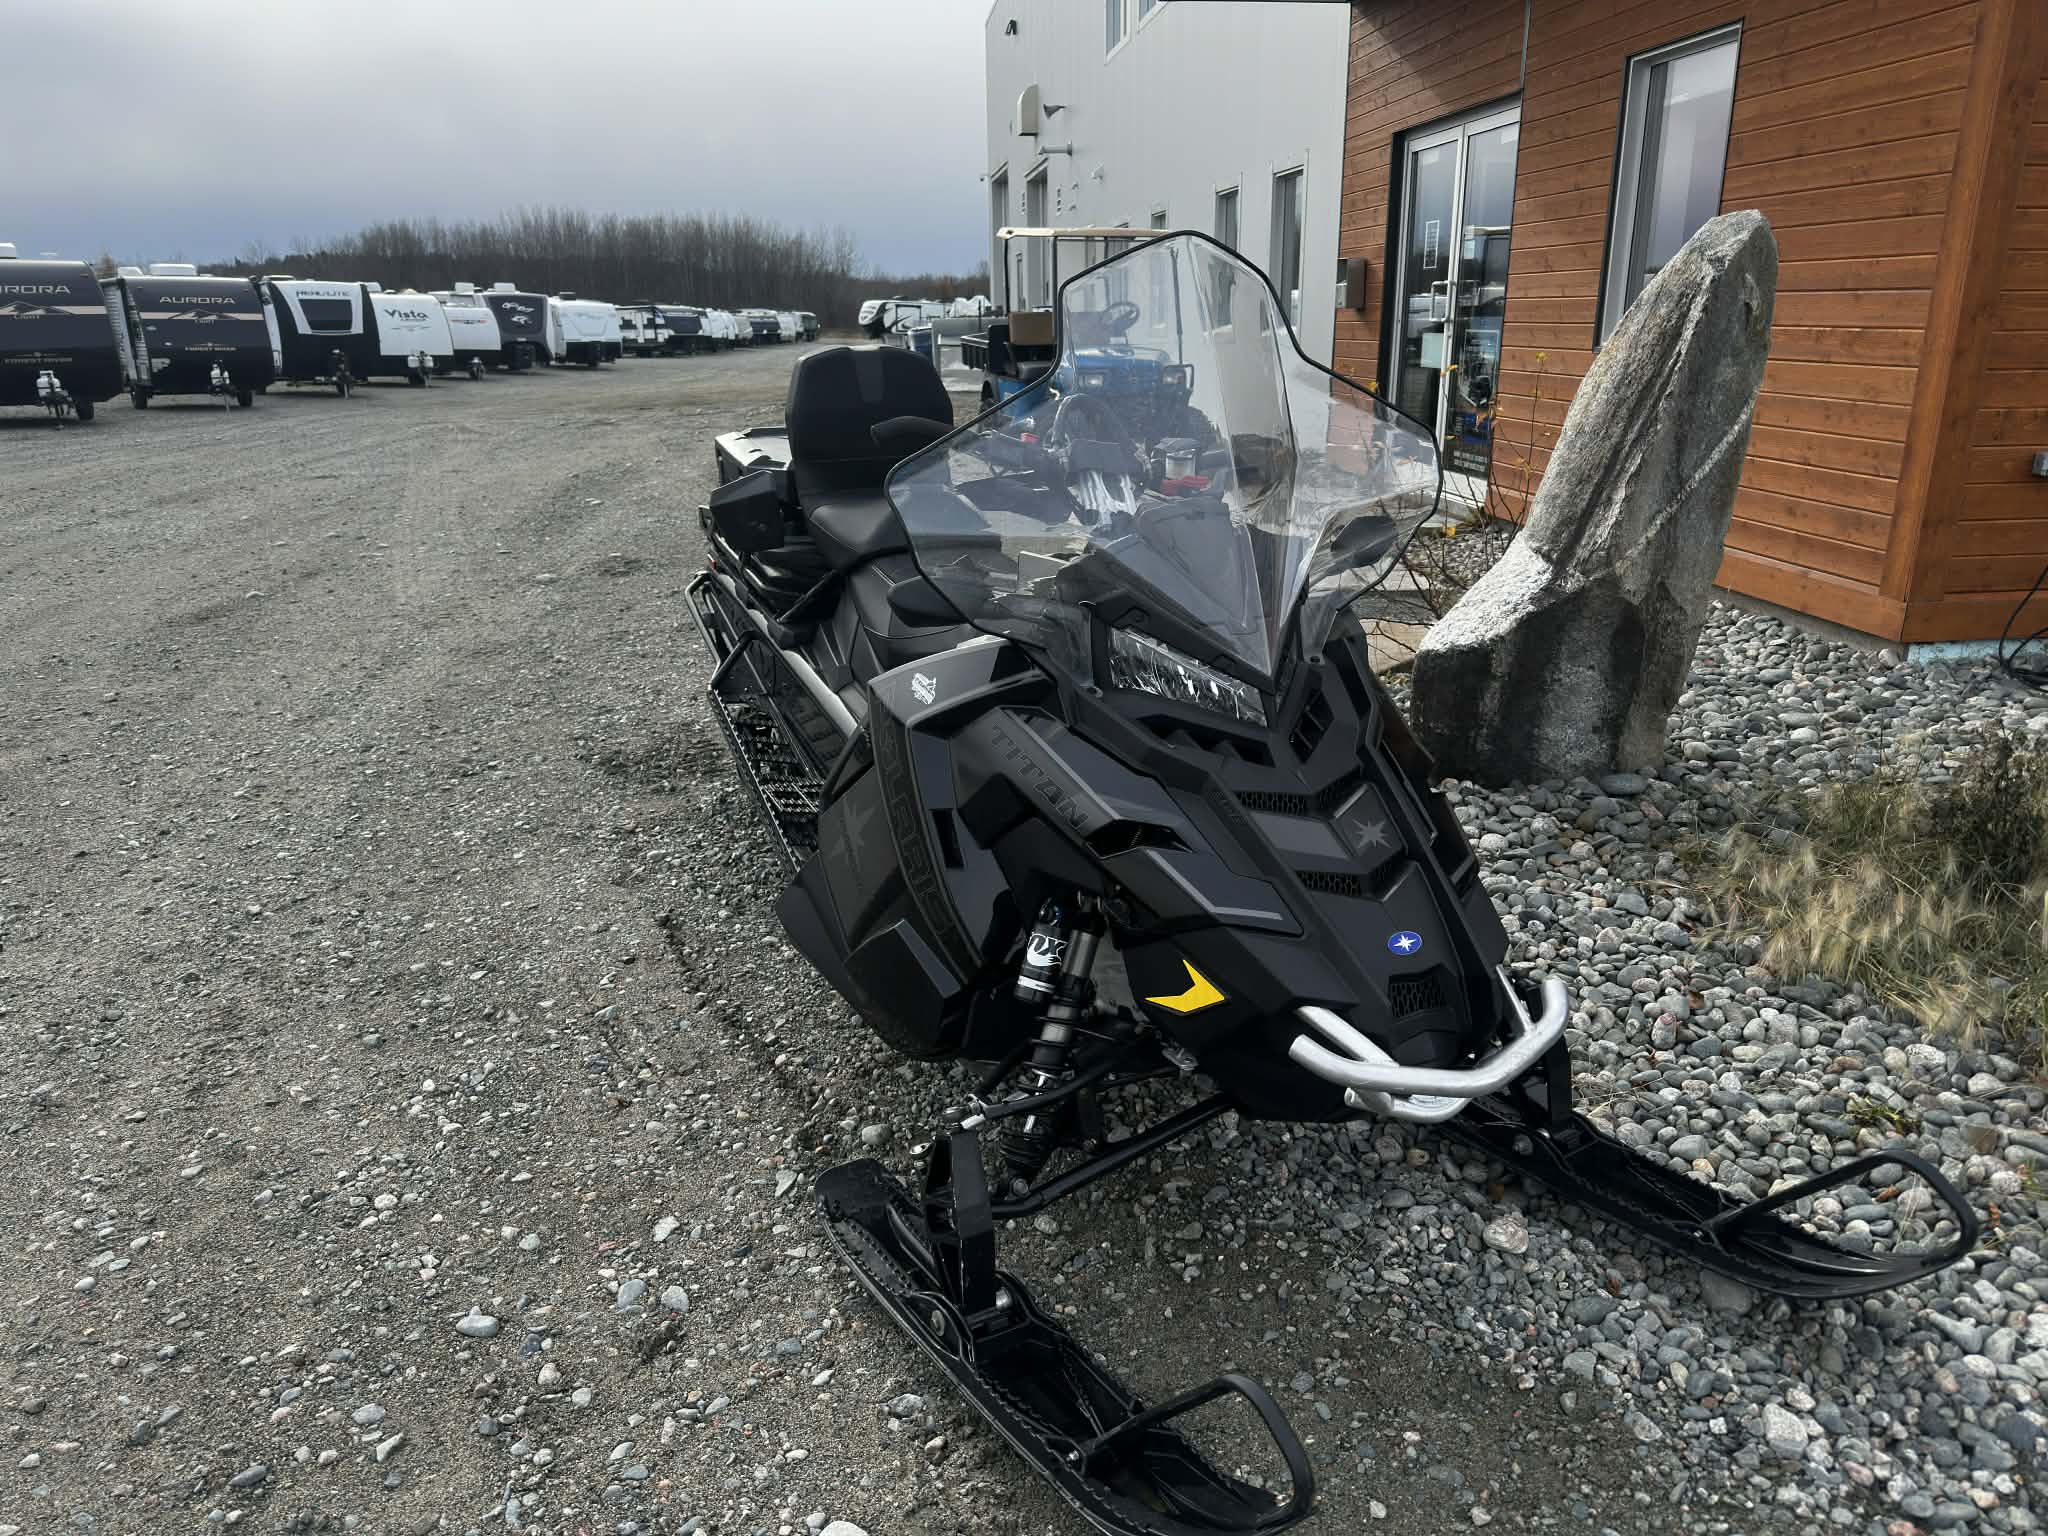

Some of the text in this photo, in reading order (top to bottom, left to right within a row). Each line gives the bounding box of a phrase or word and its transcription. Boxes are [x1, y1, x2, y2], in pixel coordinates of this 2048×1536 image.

[159, 296, 236, 304] AURORA
[384, 309, 430, 319] Vista
[989, 721, 1089, 830] TITAN
